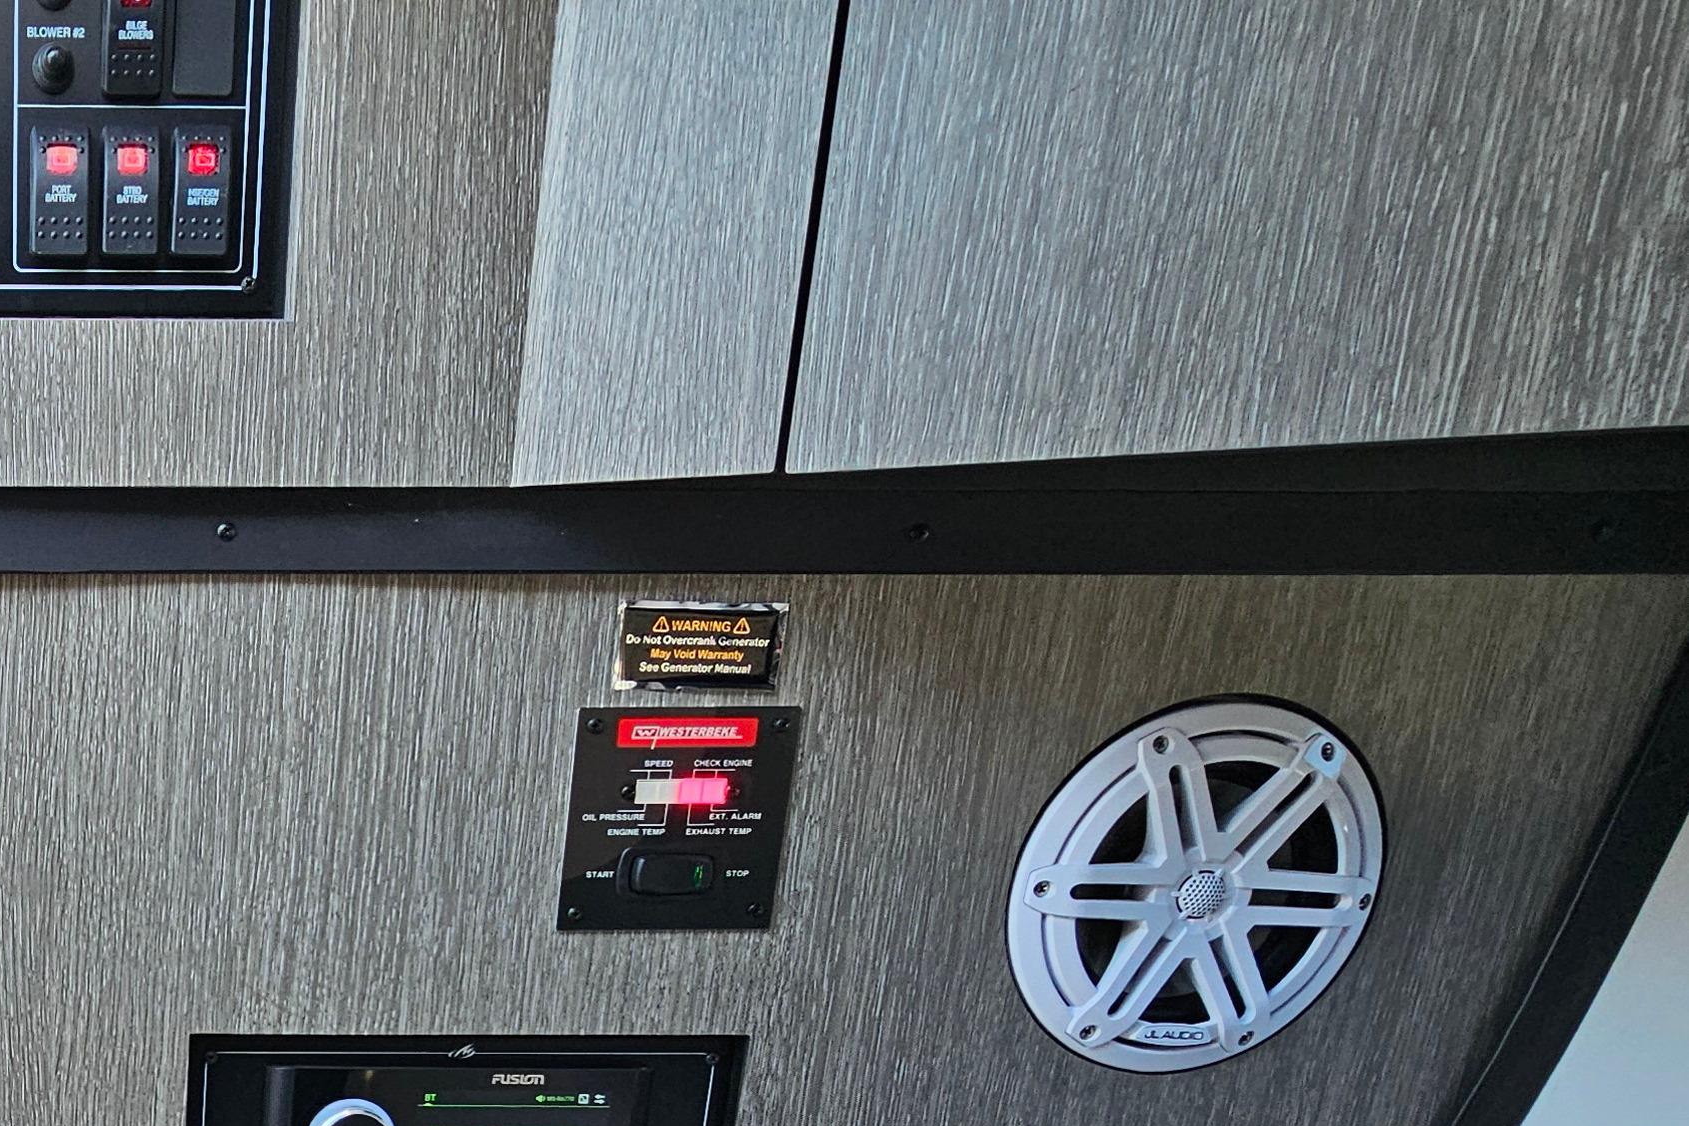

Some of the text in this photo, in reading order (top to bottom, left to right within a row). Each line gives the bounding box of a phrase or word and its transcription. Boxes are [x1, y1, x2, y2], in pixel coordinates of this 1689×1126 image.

[26, 27, 85, 39] BLOWER #2
[44, 193, 78, 203] BATTERY
[116, 194, 149, 204] BATTERY
[672, 620, 731, 632] WARNING
[626, 634, 770, 647] Do Not Overcrank Generator
[650, 648, 744, 662] May Void Warranty
[639, 662, 751, 674] See Generator Manual
[658, 726, 738, 738] WESTERBEKE
[644, 760, 673, 768] SPEED
[694, 759, 753, 767] CHECK ENGINE
[582, 813, 645, 822] OIL PRESSURE
[709, 813, 762, 821] EXT. ALARM
[607, 828, 640, 836] ENGINE
[685, 828, 752, 836] EXHAUST TEMP
[586, 870, 614, 879] START
[726, 870, 750, 878] STOP
[1161, 1031, 1204, 1040] AUDIO
[491, 1074, 545, 1085] FUSION
